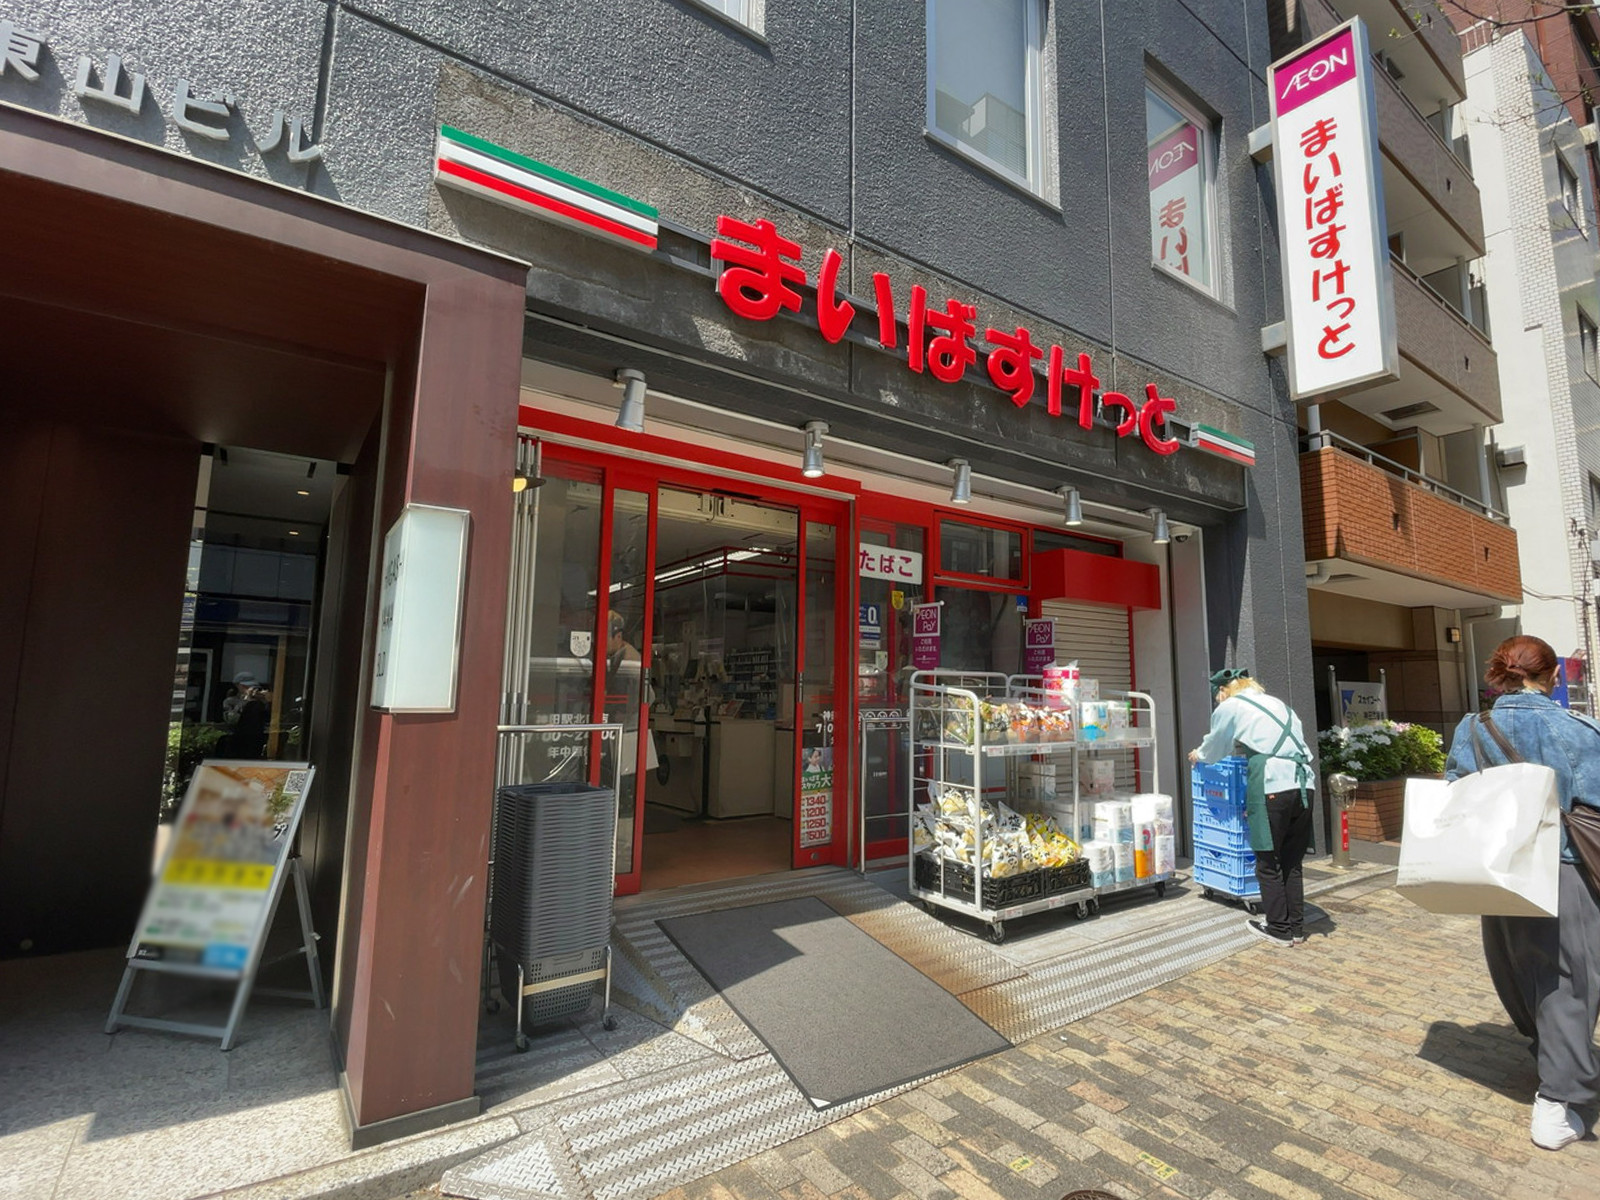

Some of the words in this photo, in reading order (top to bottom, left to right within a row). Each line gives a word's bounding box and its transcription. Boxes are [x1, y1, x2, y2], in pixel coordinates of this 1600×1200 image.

[711, 215, 1180, 455] まいばすけっと
[1300, 117, 1356, 359] まいばすけっと
[860, 550, 913, 577] たばこ
